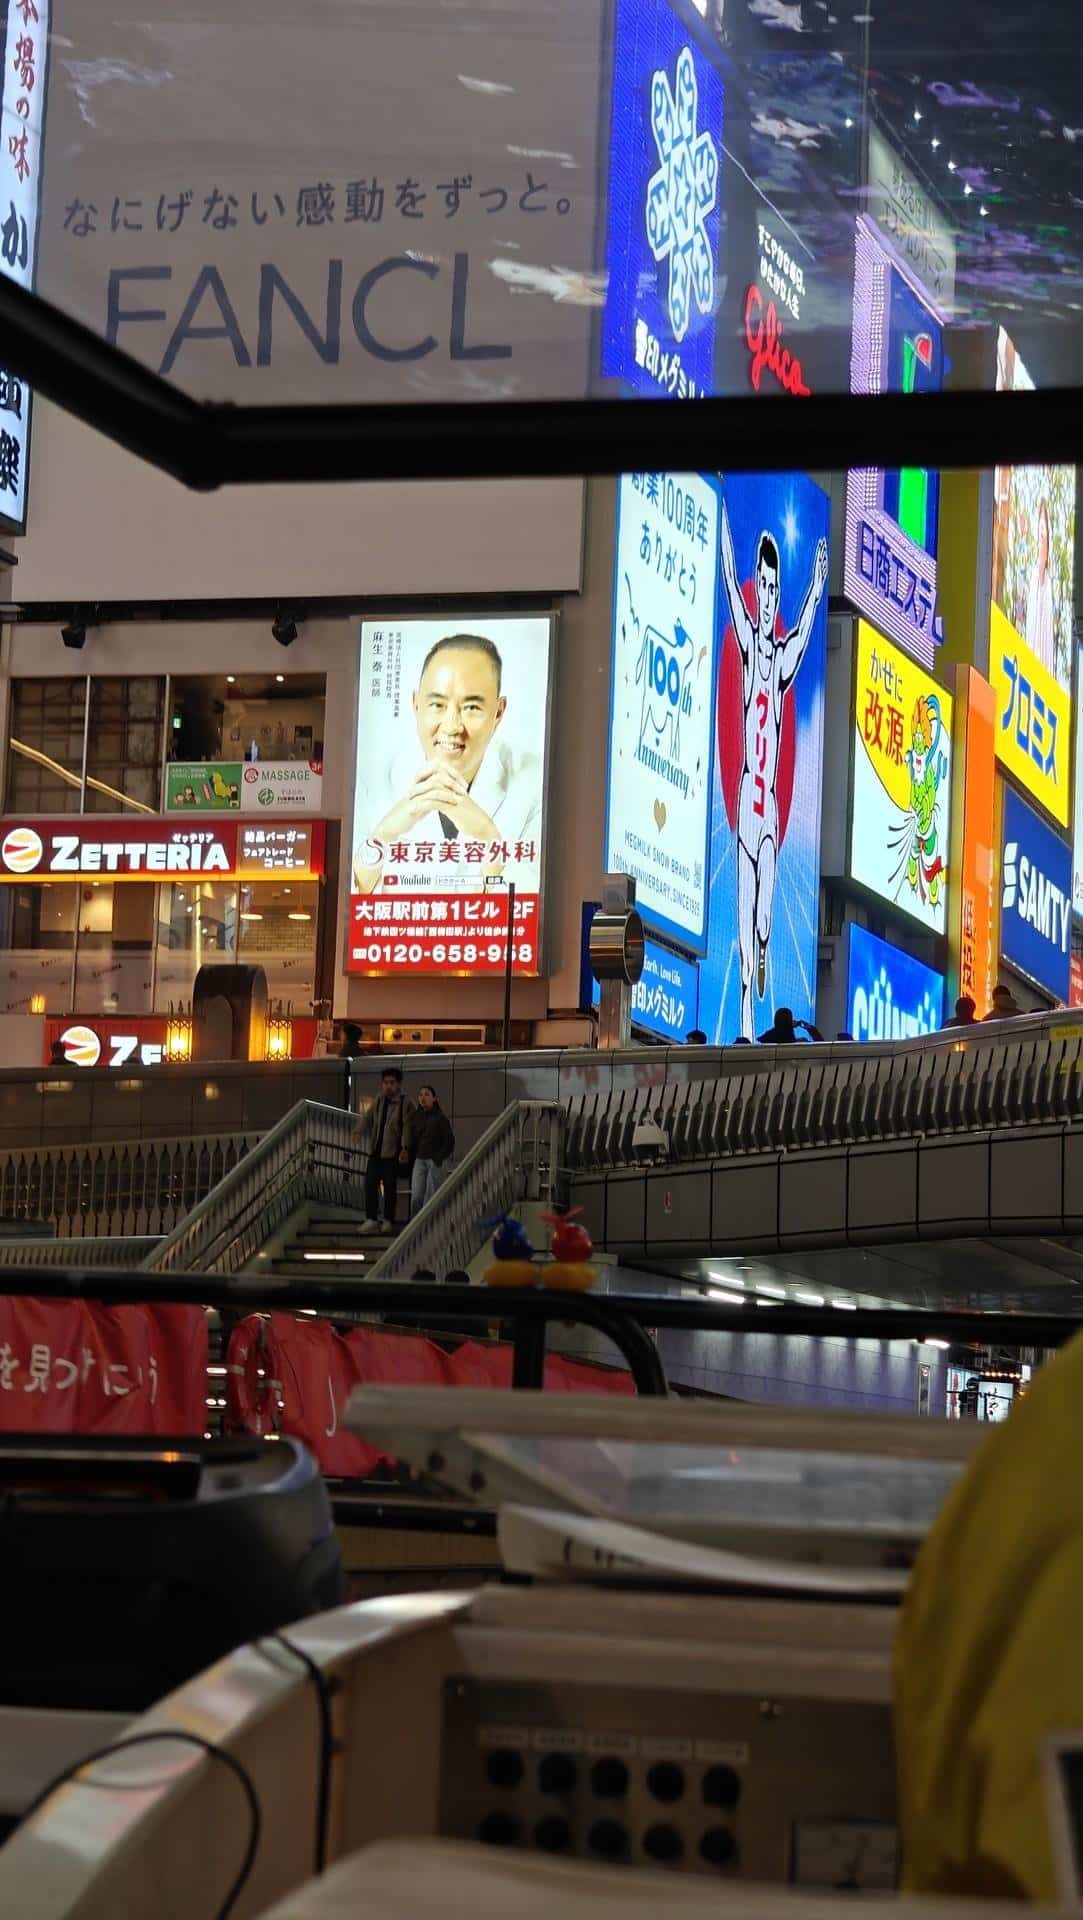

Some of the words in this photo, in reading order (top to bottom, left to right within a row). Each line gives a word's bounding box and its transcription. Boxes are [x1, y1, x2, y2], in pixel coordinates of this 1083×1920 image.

[63, 172, 572, 237] なにげない感動をずっと。
[104, 253, 512, 374] FANCL
[640, 519, 697, 605] ありがとう
[864, 688, 906, 767] 改源
[1002, 654, 1058, 785] プロミス
[261, 768, 310, 781] MASSAGE
[634, 744, 690, 800] Anniversary
[753, 688, 770, 818] グリコ
[49, 836, 230, 871] ZETTERIA
[263, 857, 305, 869] コーヒー
[389, 841, 537, 864] 東京美容外科
[400, 874, 431, 886] YouTube
[355, 900, 500, 921] 大阪駅前第1ビル
[1018, 855, 1072, 953] SAMTY
